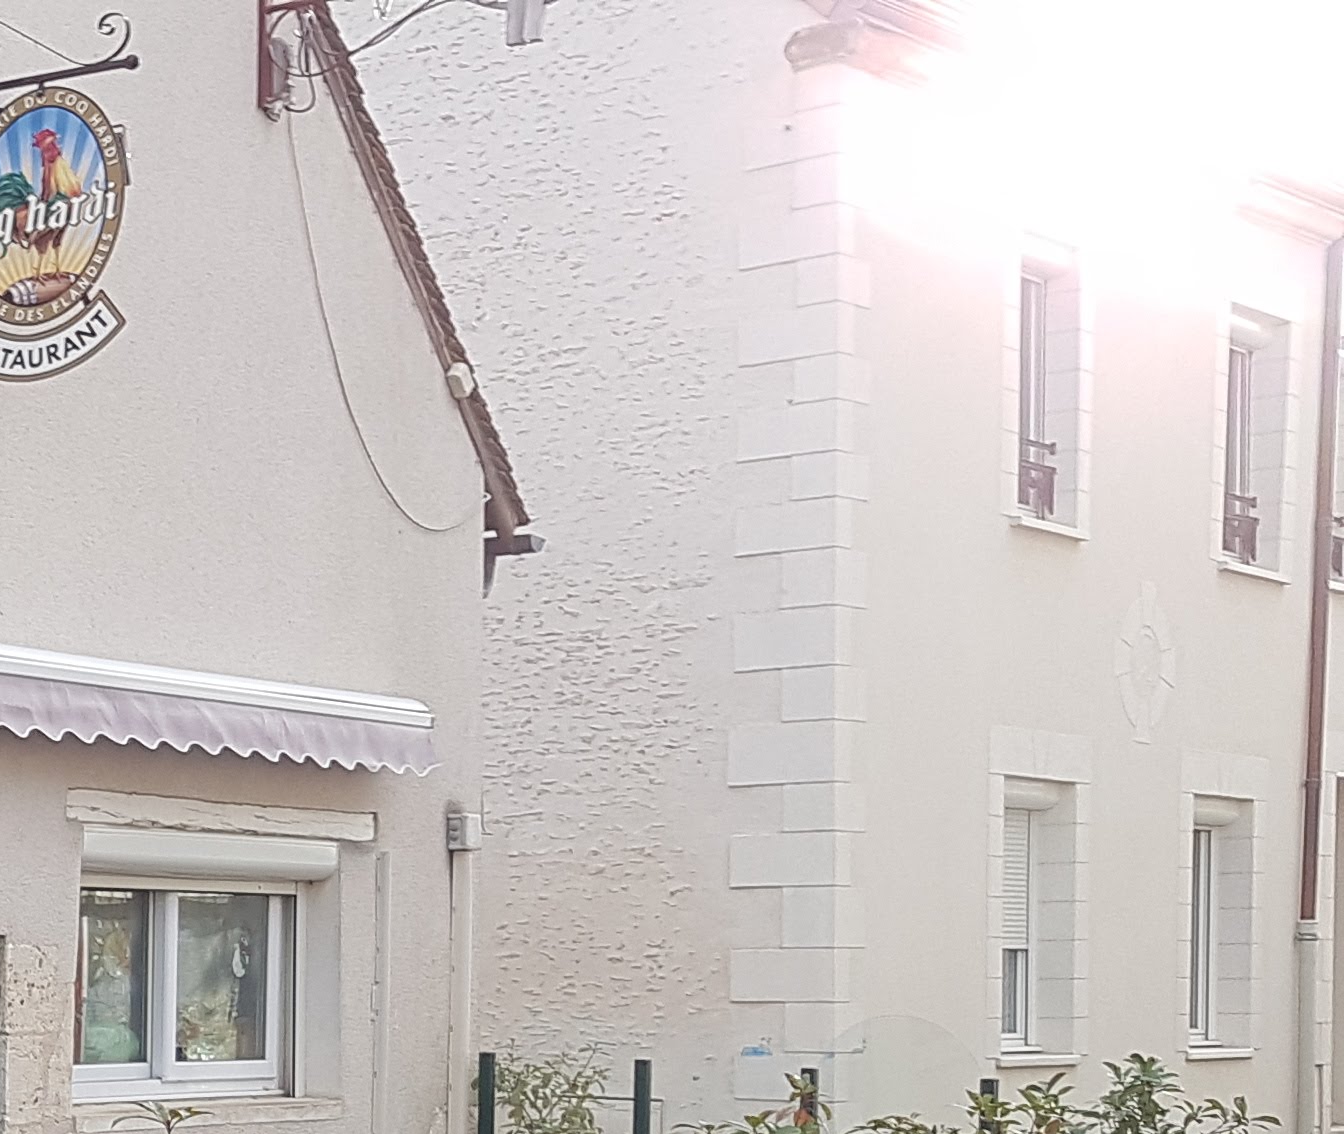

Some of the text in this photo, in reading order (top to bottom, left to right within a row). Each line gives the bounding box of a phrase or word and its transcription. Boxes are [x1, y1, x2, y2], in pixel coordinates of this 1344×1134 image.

[54, 91, 89, 115] COQ
[89, 113, 119, 166] HARDI
[25, 181, 118, 234] hardi
[14, 308, 44, 321] DES
[50, 233, 113, 314] FLANDRES
